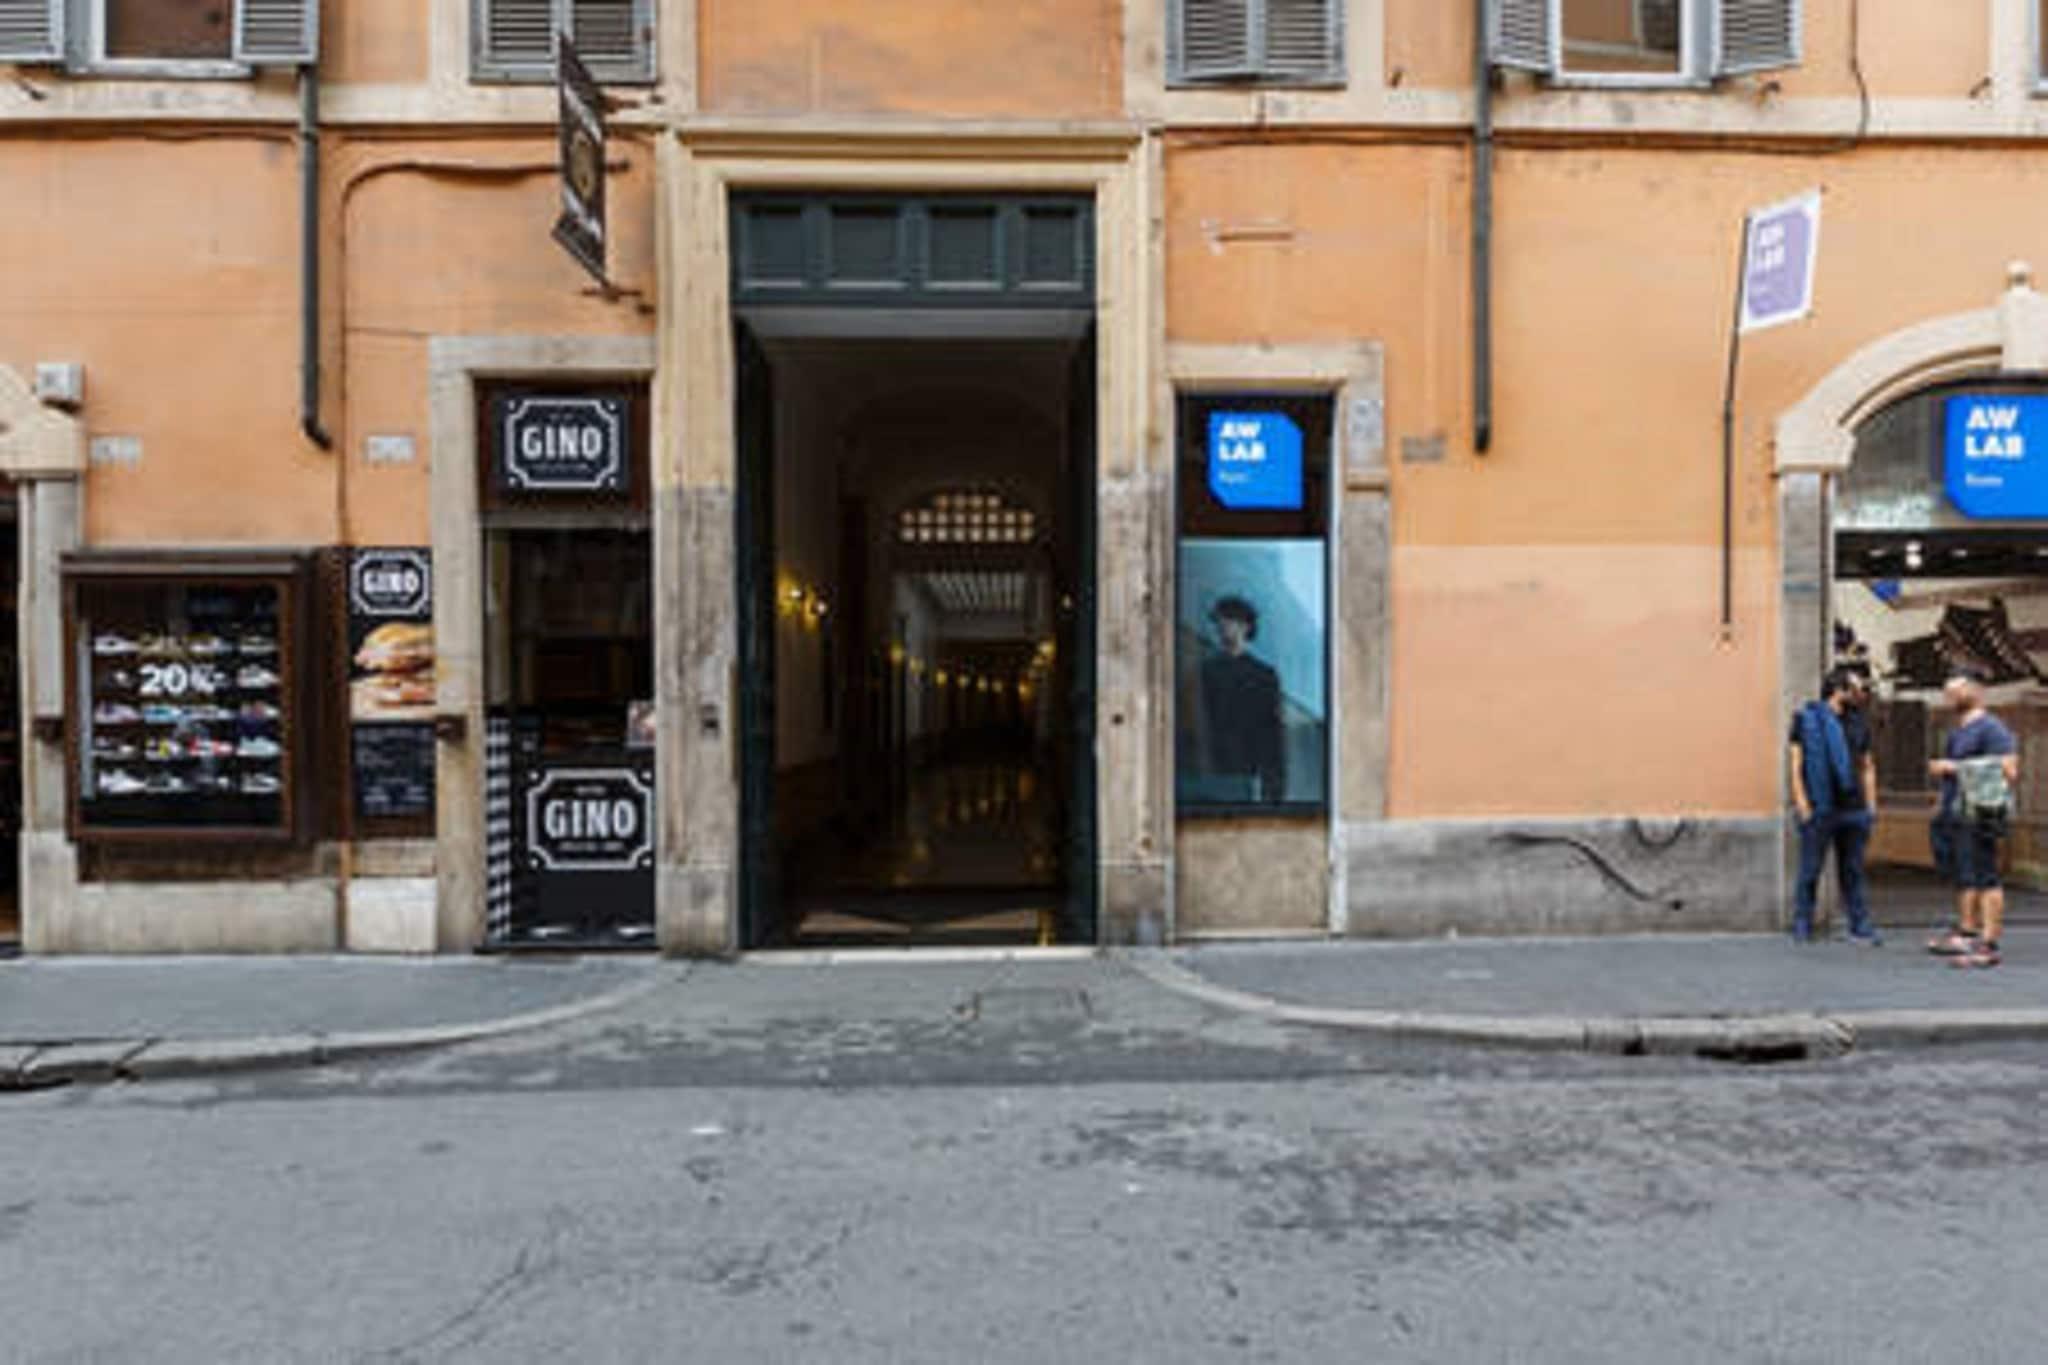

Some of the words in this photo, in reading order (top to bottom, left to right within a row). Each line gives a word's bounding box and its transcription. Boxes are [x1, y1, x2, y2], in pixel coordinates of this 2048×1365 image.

[1965, 405, 2018, 429] AW
[1219, 421, 1262, 439] AW
[521, 425, 602, 460] GINO
[1218, 441, 1267, 461] LAB
[1965, 435, 2024, 459] LAB
[363, 570, 419, 594] GINO
[544, 799, 637, 838] GINO
